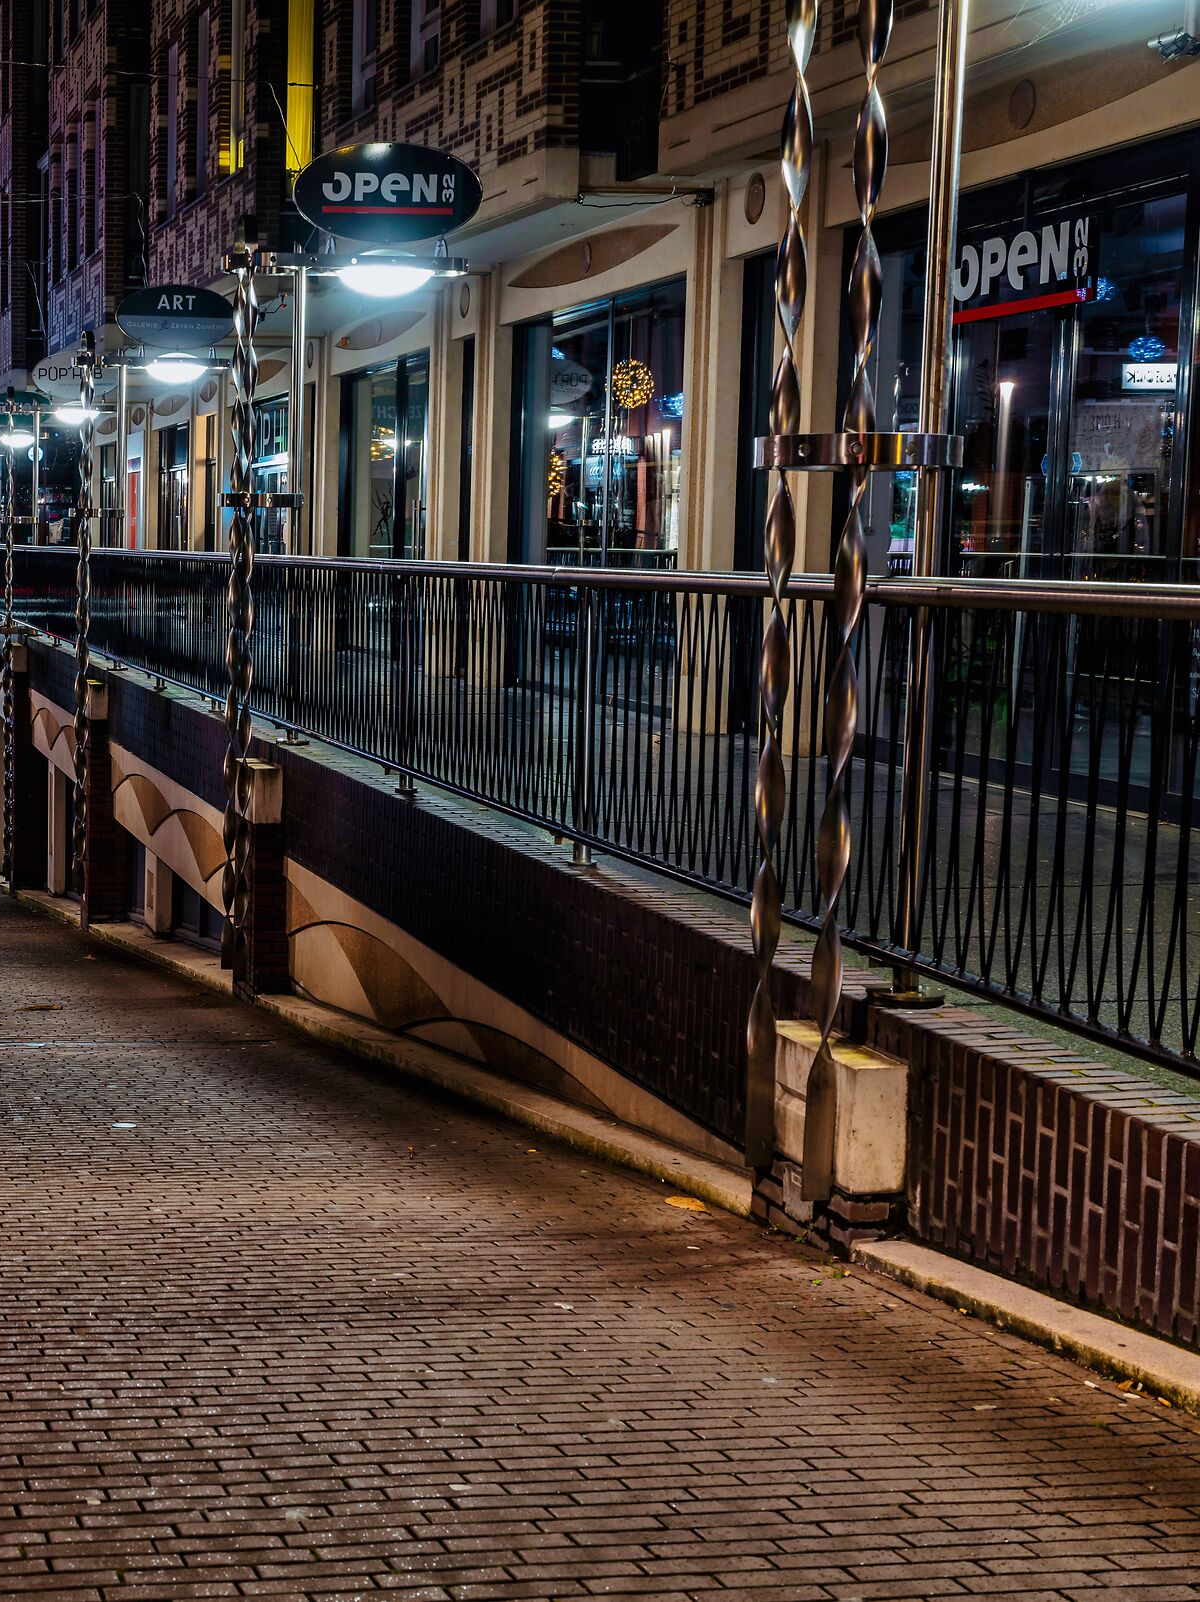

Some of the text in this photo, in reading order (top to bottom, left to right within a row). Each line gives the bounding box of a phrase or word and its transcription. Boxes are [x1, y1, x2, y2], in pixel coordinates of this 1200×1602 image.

[441, 174, 456, 203] 32
[1073, 217, 1090, 277] 32
[157, 294, 196, 311] ART
